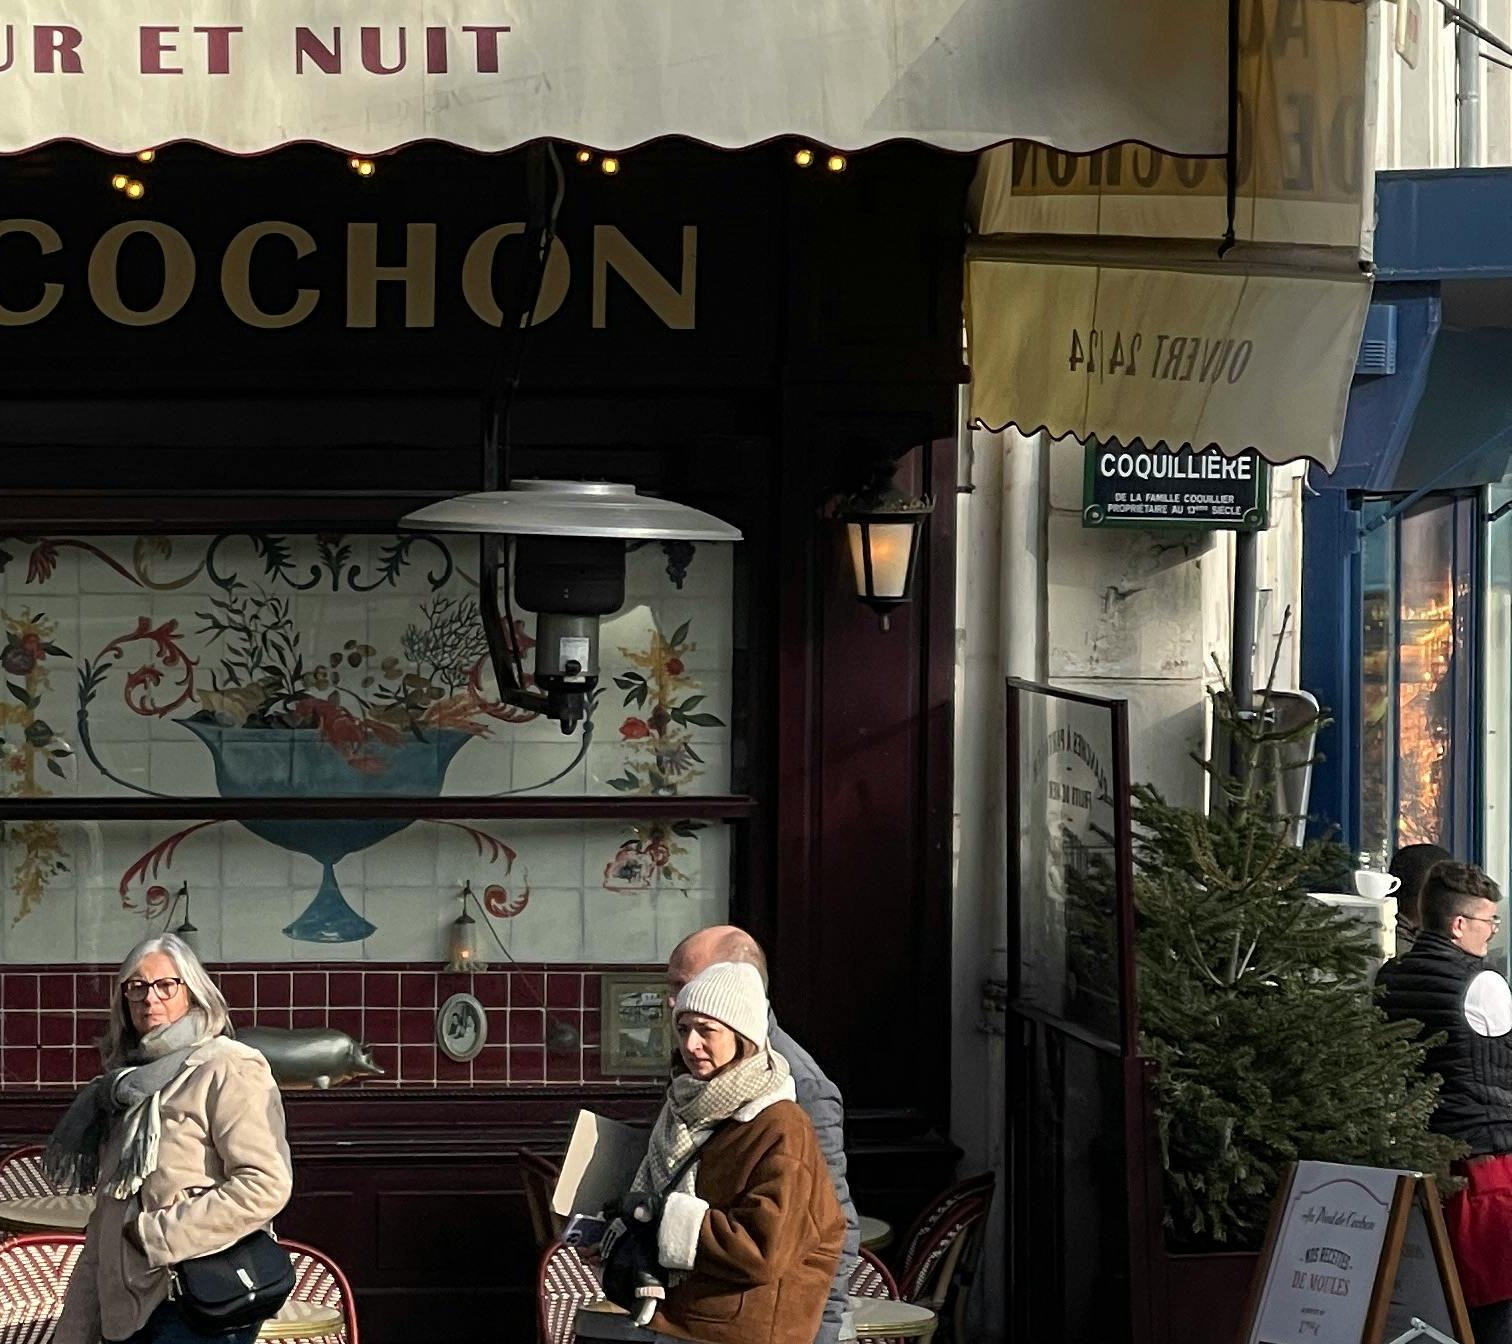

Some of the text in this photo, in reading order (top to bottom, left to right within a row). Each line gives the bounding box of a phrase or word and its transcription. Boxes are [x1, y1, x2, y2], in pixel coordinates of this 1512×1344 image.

[139, 25, 243, 76] ET
[295, 25, 511, 76] NUIT
[1100, 449, 1252, 480] COQUILLIÈRE
[1114, 492, 1235, 504] DE LA FAMILLE COQUILLIER
[1171, 505, 1184, 514] AU
